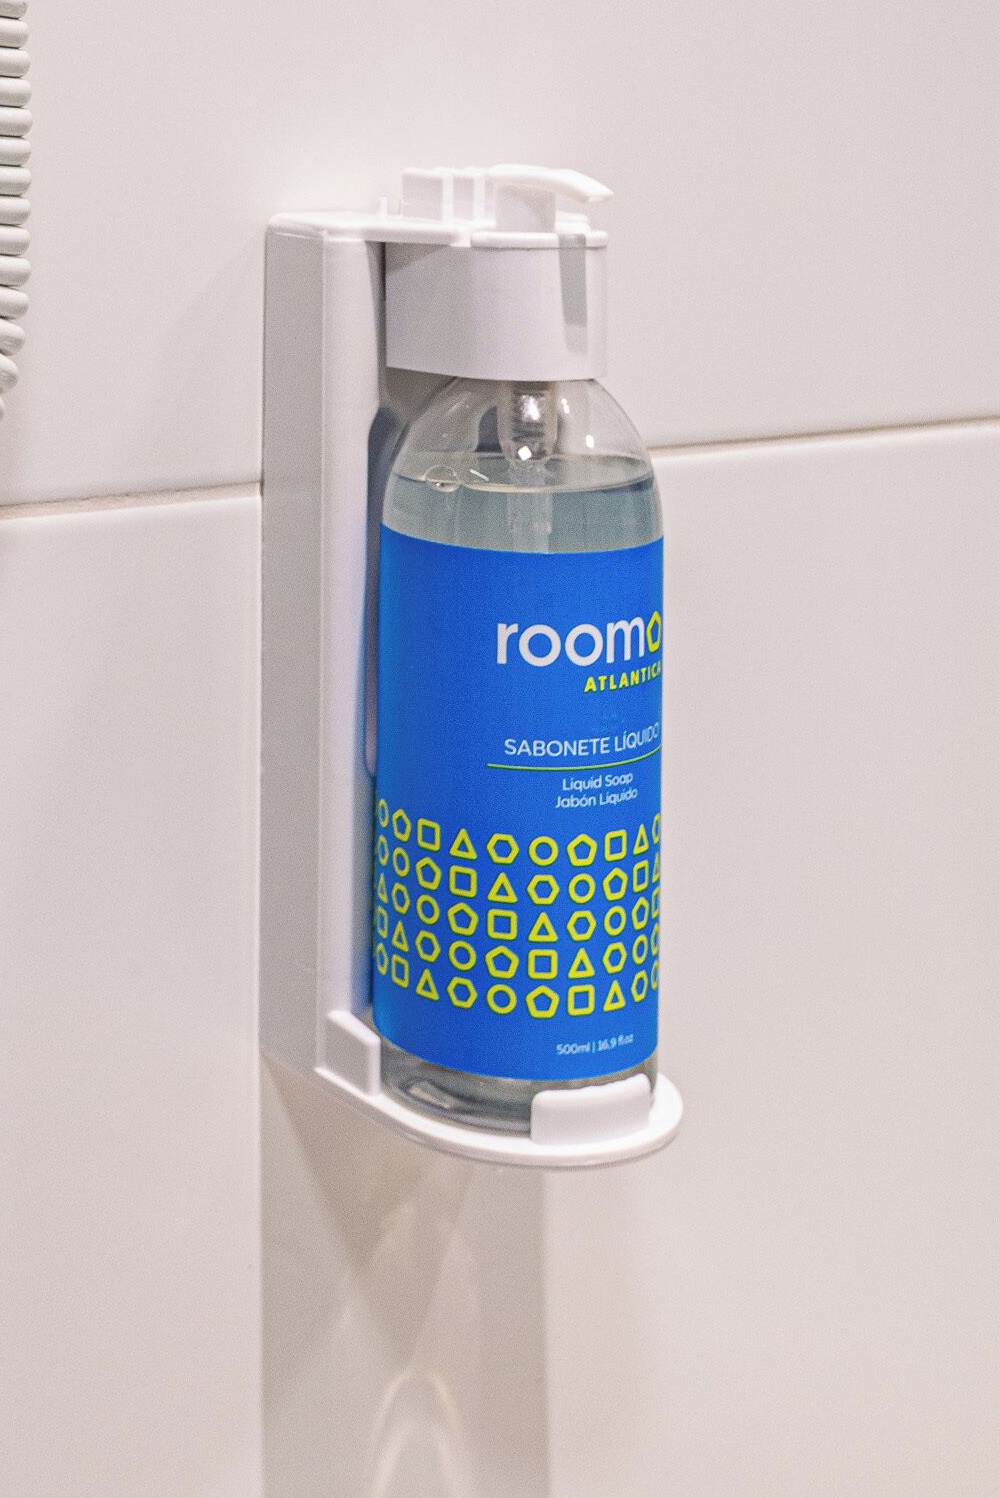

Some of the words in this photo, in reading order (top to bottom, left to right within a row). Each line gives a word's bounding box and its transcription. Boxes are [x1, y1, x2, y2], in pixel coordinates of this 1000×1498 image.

[504, 736, 611, 757] SABONETE
[562, 775, 602, 792] Liquid
[605, 772, 633, 787] Soap
[555, 793, 597, 809] Jabón
[556, 1042, 591, 1055] 500ml
